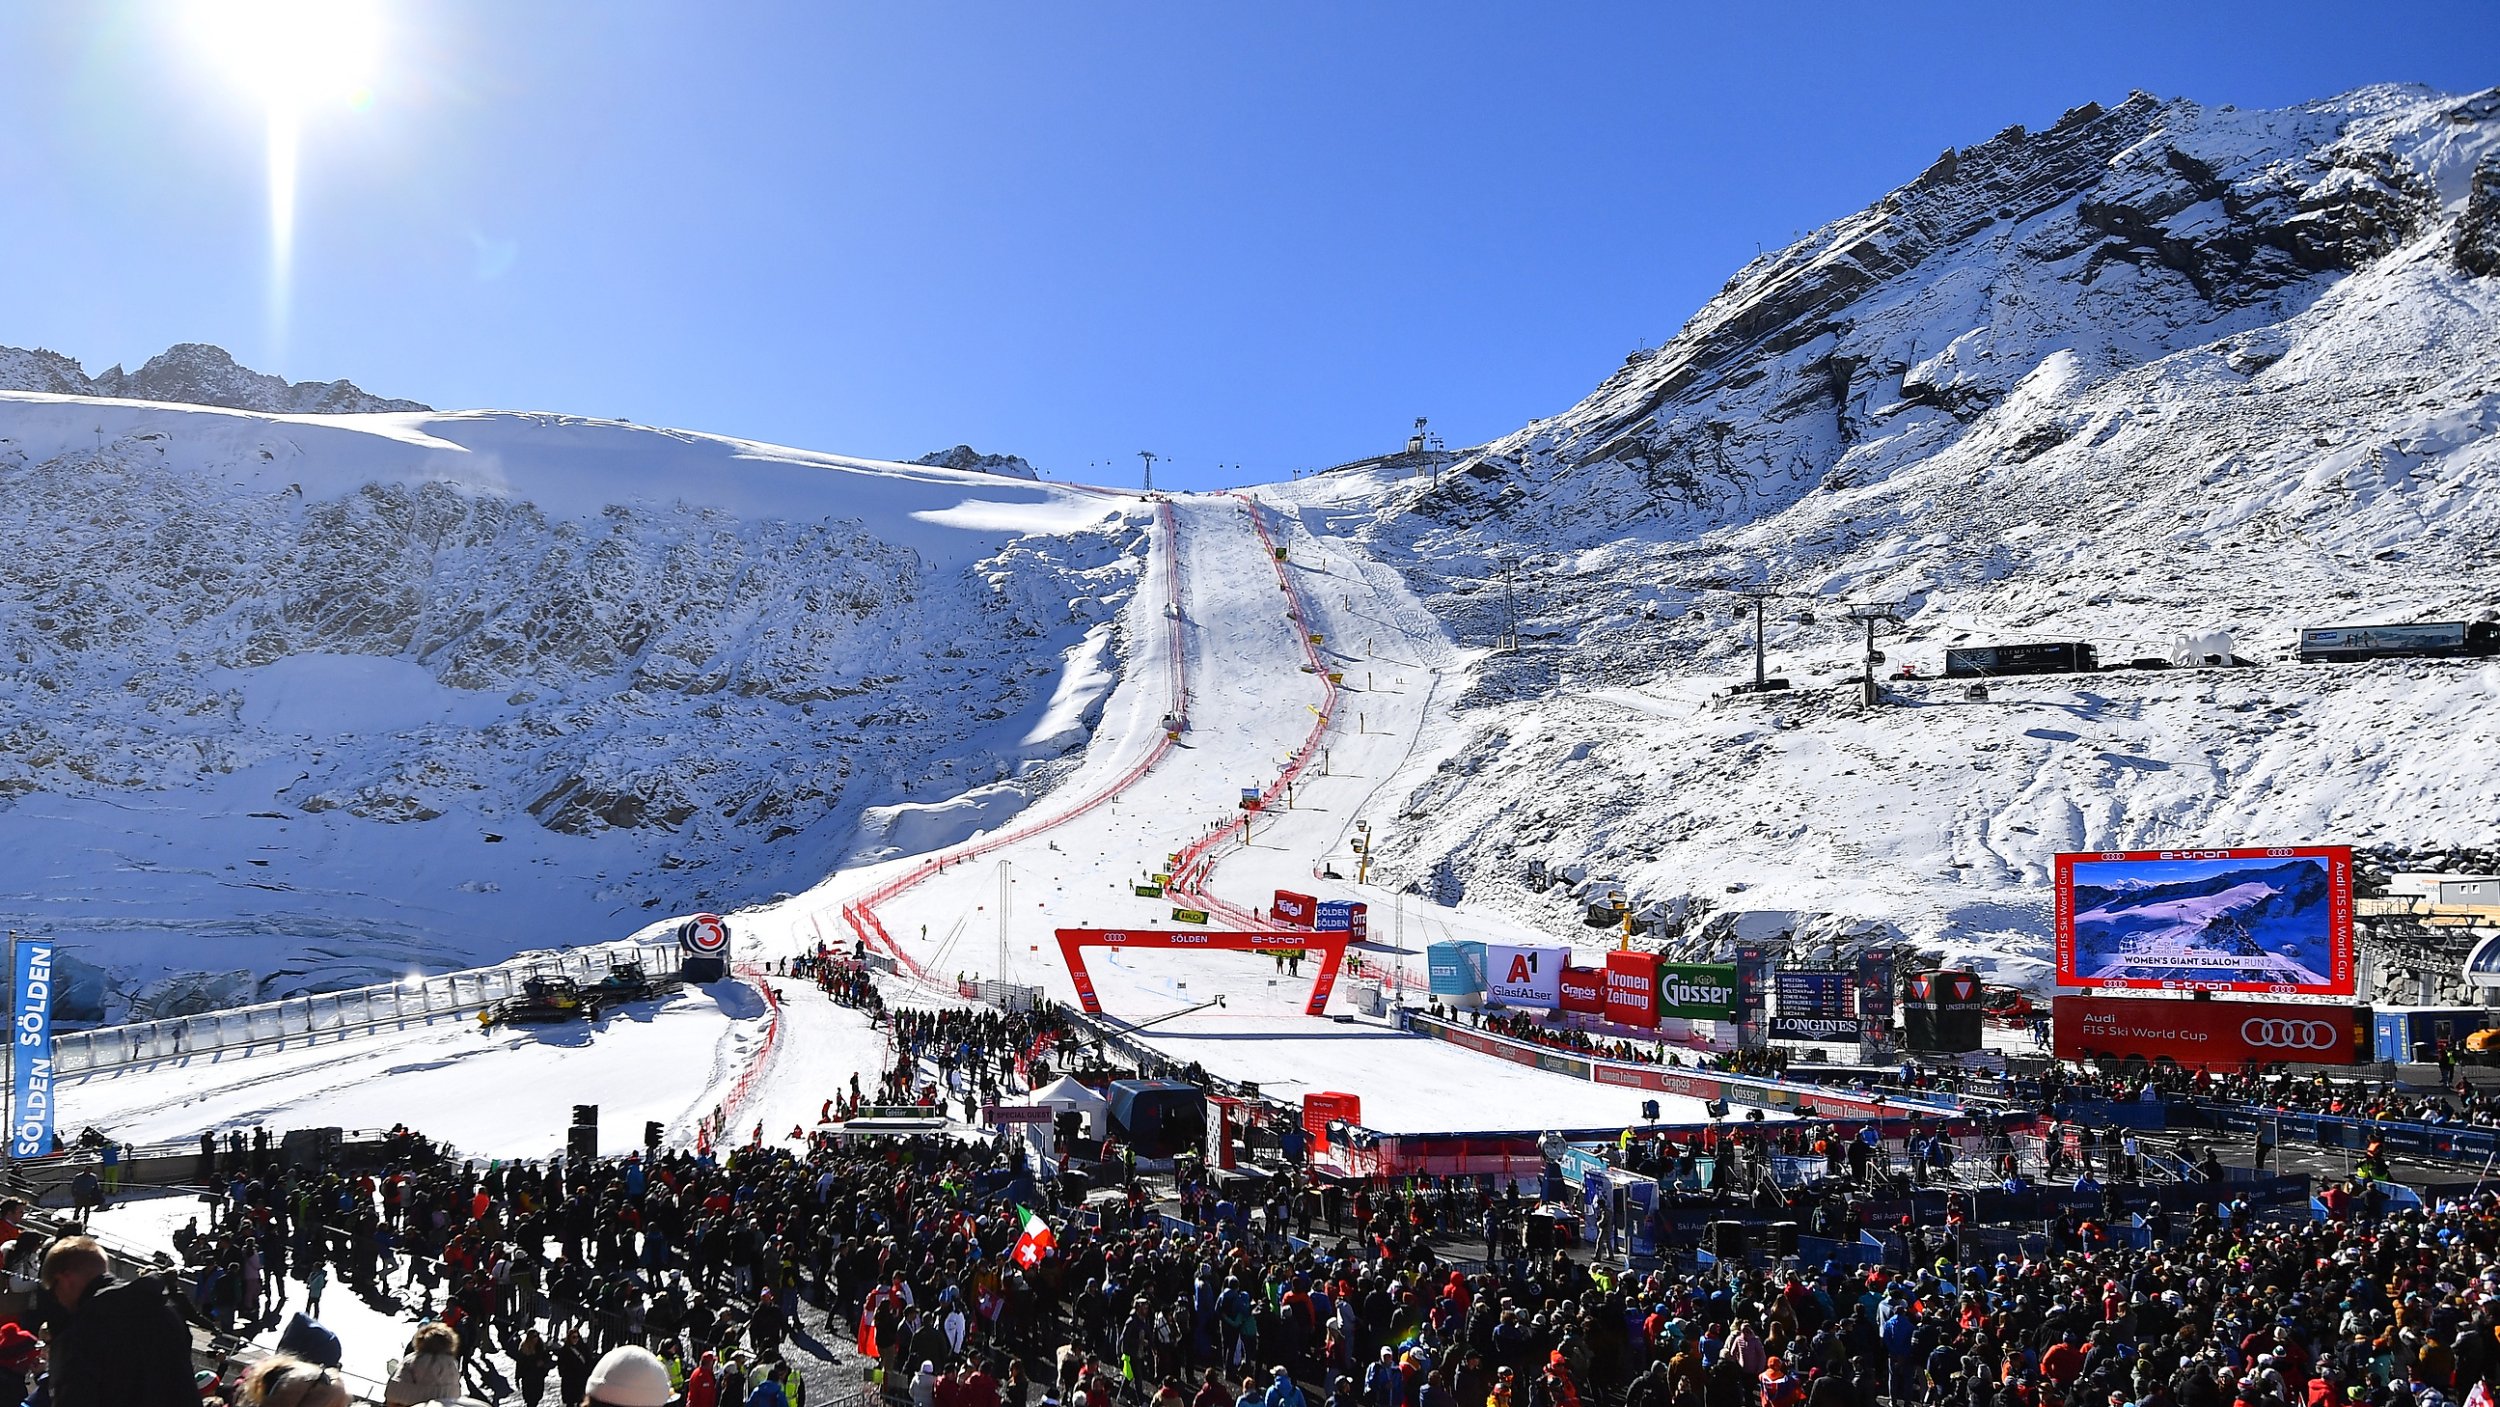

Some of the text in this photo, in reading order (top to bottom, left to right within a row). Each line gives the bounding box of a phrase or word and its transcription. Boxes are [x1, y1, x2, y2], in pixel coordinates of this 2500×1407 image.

[1999, 648, 2040, 656] ELEMENTS
[2160, 850, 2229, 859] e-tron
[2060, 867, 2068, 884] Cup
[1277, 899, 1302, 917] Tirol
[2060, 887, 2068, 916] World
[1318, 906, 1349, 916] SÖLDEN
[1318, 918, 1348, 928] SÖLDEN
[2336, 861, 2347, 981] Audi FIS Ski World Cup
[1171, 934, 1208, 943] SÖLDEN
[1251, 936, 1304, 944] e-tron
[1506, 951, 1538, 983] A1
[2124, 956, 2272, 967] WOMEN'S GIANT SLALOM RUN 2
[1606, 970, 1649, 990] Kronen
[2162, 981, 2232, 991] e-tron
[17, 946, 51, 1047] SÖLDEN
[1492, 985, 1552, 1000] GlasfA1ser
[1662, 974, 1732, 1007] Gösser
[1606, 988, 1649, 1010] Zeitung
[1776, 1018, 1858, 1032] LONGINES
[2084, 1013, 2116, 1023] Audi
[2083, 1025, 2208, 1042] FIS Ski World Cup
[1600, 1069, 1642, 1086] Kronen Zeitung
[1661, 1074, 1690, 1092] Grapos
[1731, 1084, 1760, 1100] Gösser
[1970, 1086, 1999, 1096] 12:51:14
[16, 1058, 50, 1155] SÖLDEN
[1812, 1099, 1876, 1118] Kronen Zeitung
[996, 1110, 1050, 1119] SPECIAL GUEST
[2464, 1146, 2489, 1154] Austria
[2070, 1201, 2094, 1210] Austria
[1678, 1222, 1689, 1230] Ski
